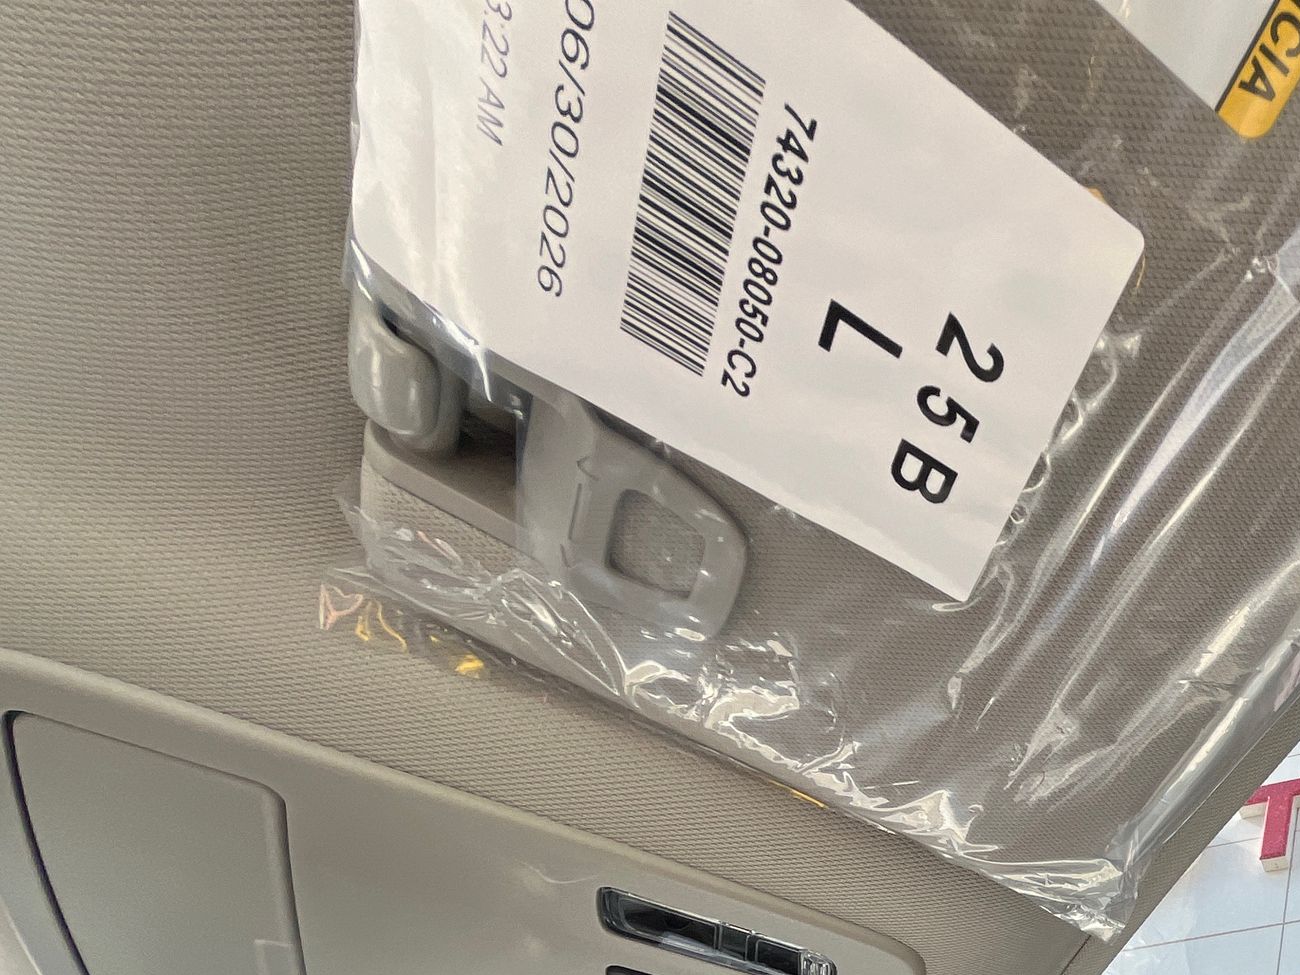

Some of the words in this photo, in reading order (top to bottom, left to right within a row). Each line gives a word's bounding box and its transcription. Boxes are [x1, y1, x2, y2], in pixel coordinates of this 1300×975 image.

[475, 77, 506, 147] AM
[536, 0, 595, 299] 06/30/2026
[721, 102, 818, 398] 74320-08050-C2
[817, 298, 904, 359] L
